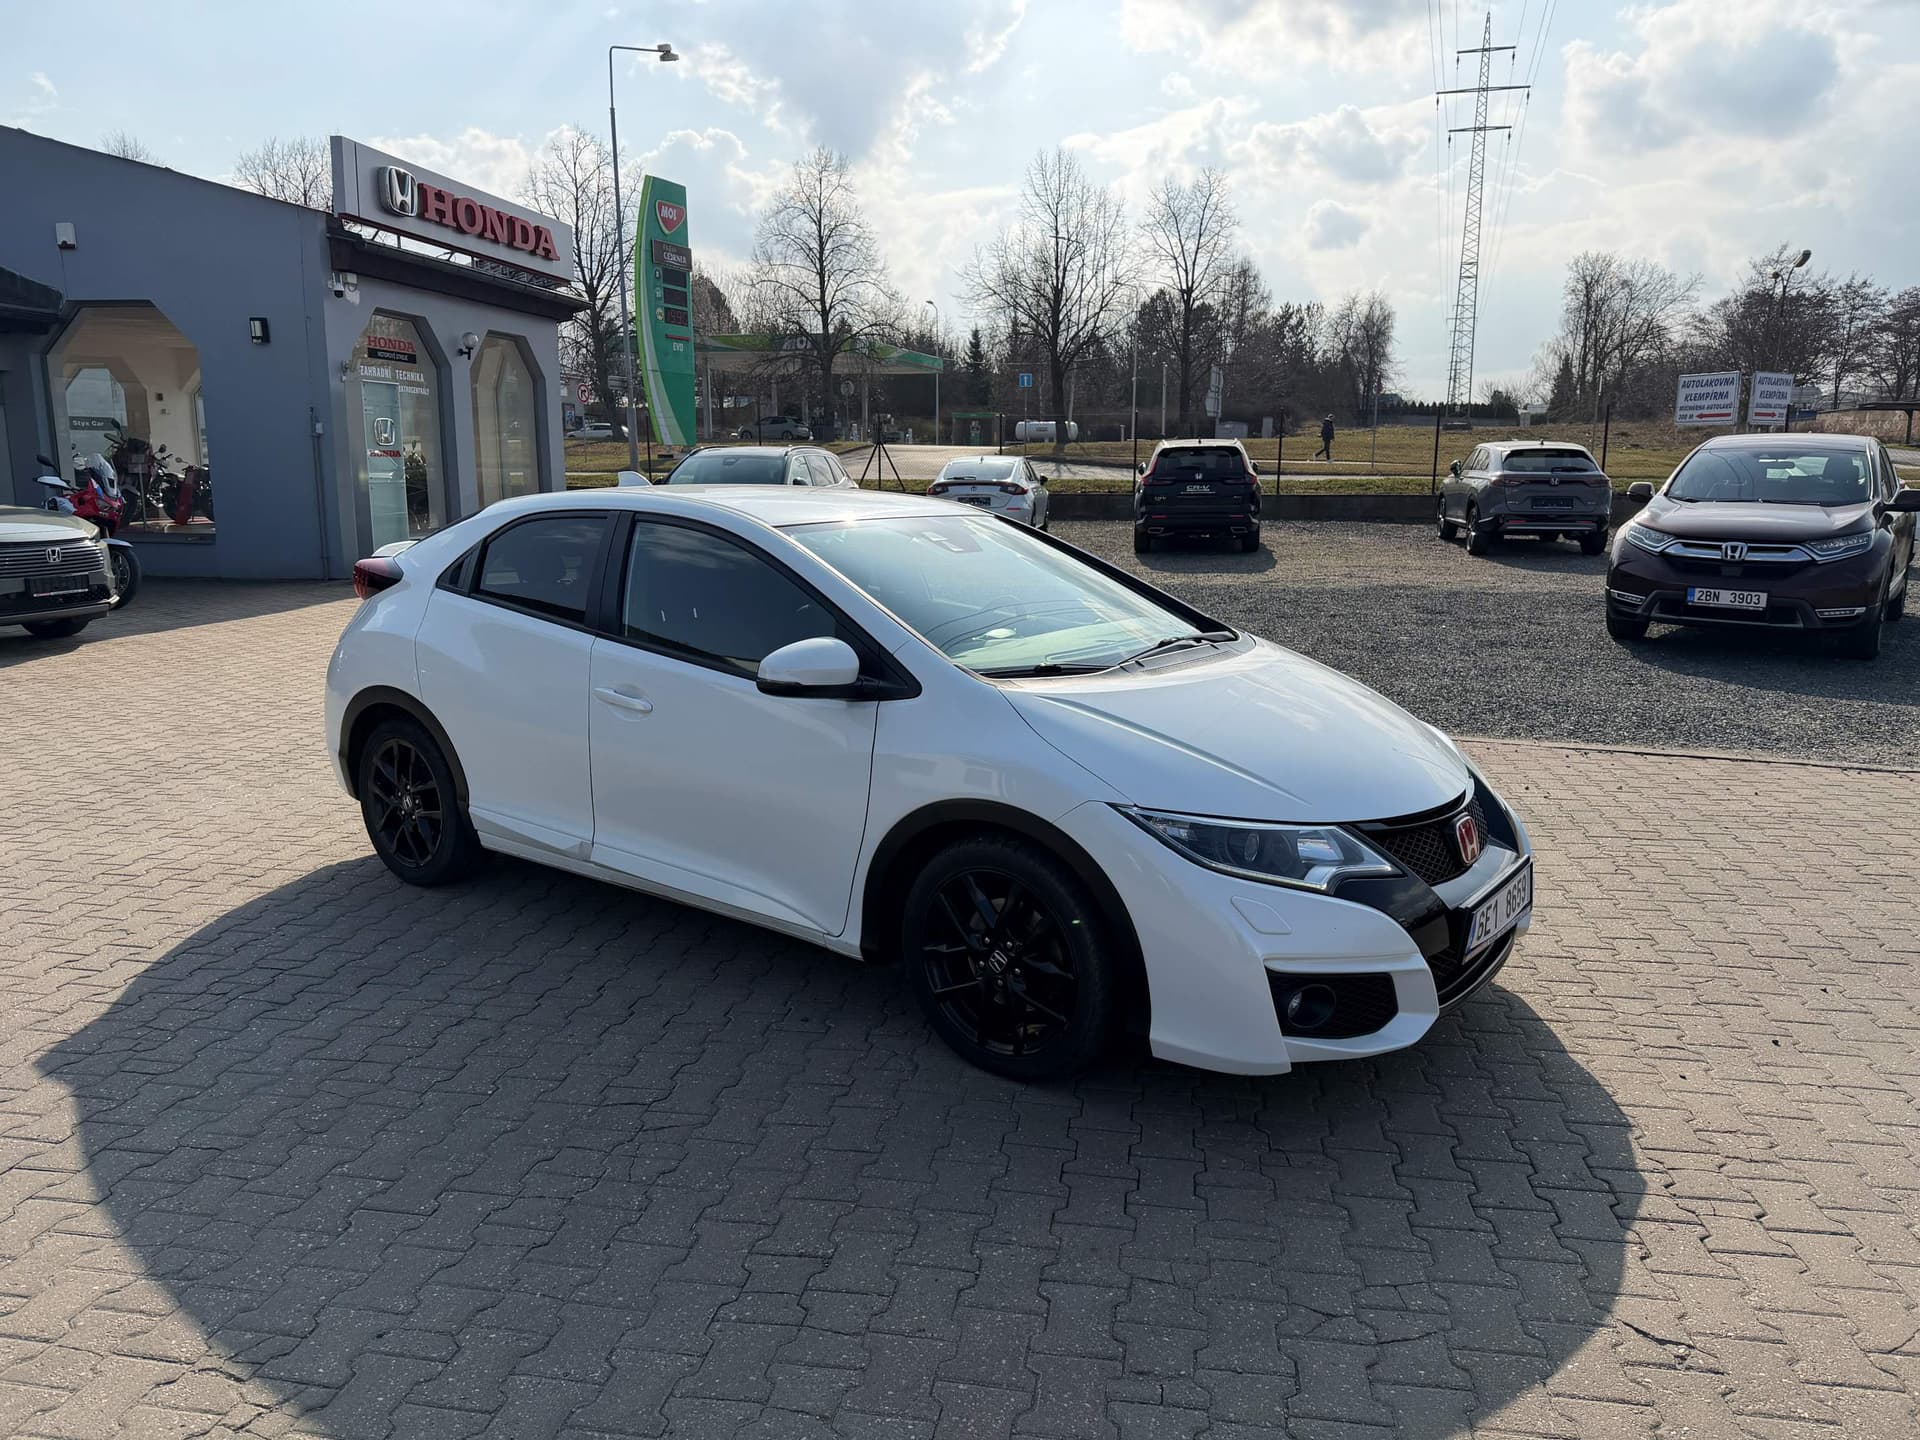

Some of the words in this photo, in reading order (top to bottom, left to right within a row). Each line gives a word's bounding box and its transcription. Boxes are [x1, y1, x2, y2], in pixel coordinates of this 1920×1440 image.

[418, 183, 561, 261] HONDA
[367, 336, 416, 352] HONDA
[672, 342, 684, 352] EVO
[395, 369, 425, 382] TECHNIKA
[1681, 376, 1735, 389] AUTOLAKOVNA
[1683, 390, 1729, 402] KLEMPÍRNA
[1697, 590, 1720, 602] 2BN
[1729, 592, 1761, 605] 3903
[1476, 899, 1499, 941] 6E1
[1505, 873, 1527, 919] 8659
